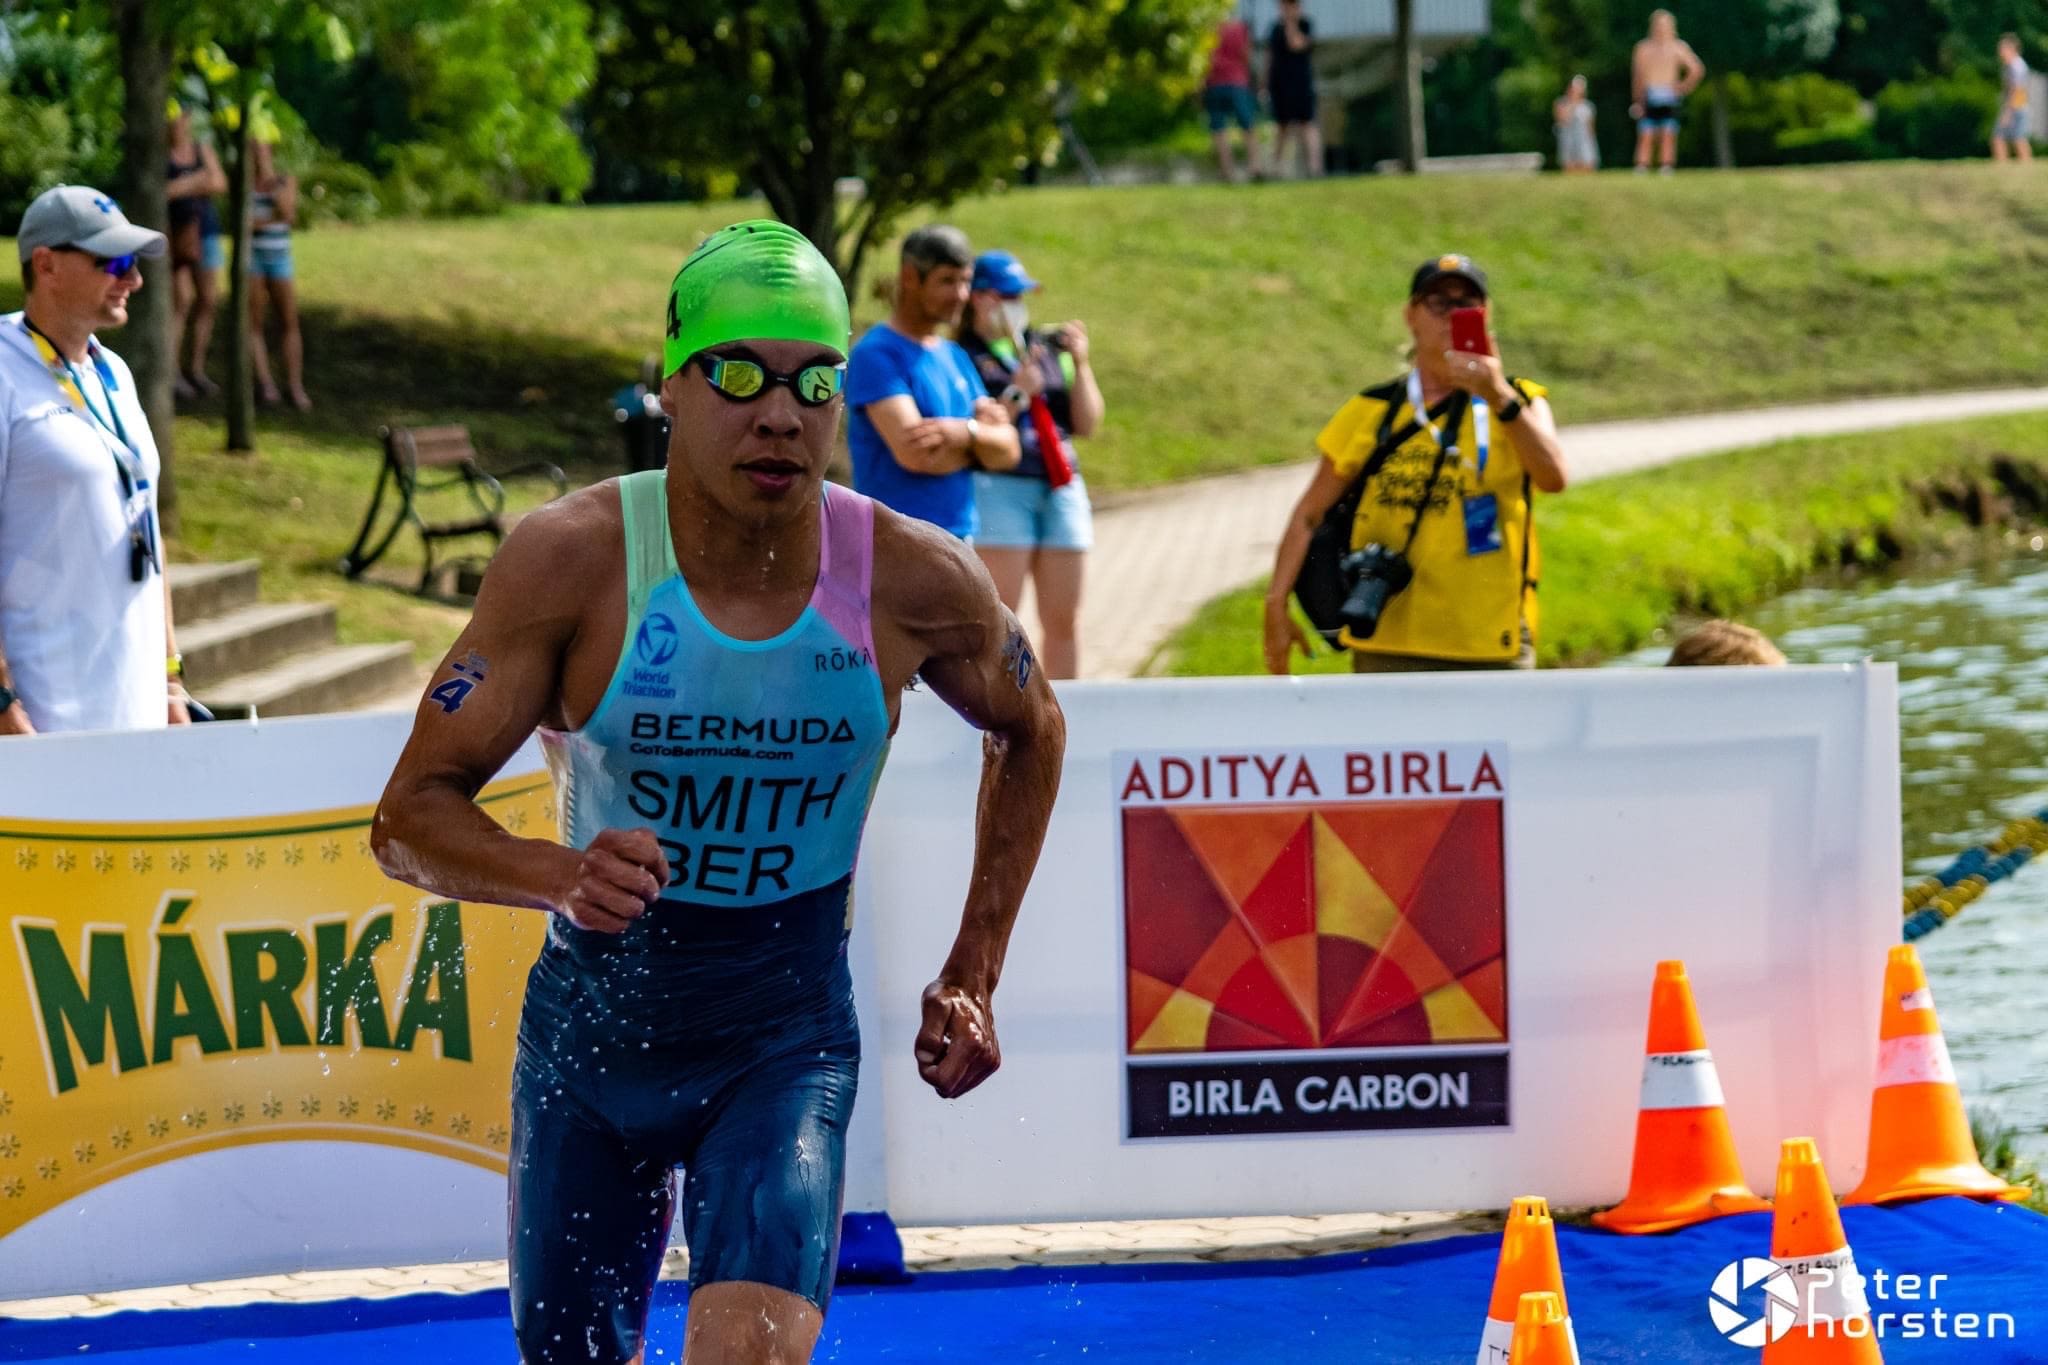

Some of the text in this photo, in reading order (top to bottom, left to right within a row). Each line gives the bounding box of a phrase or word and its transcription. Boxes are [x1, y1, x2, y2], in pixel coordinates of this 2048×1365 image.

[429, 676, 476, 714] 4
[633, 667, 670, 685] World
[630, 712, 856, 745] BERMUDA
[1120, 749, 1504, 801] ADITYA BIRLA
[627, 769, 848, 833] SMITH
[657, 836, 795, 897] BER
[17, 895, 474, 1095] MÁRKA
[1167, 1071, 1470, 1118] BIRLA CARBON
